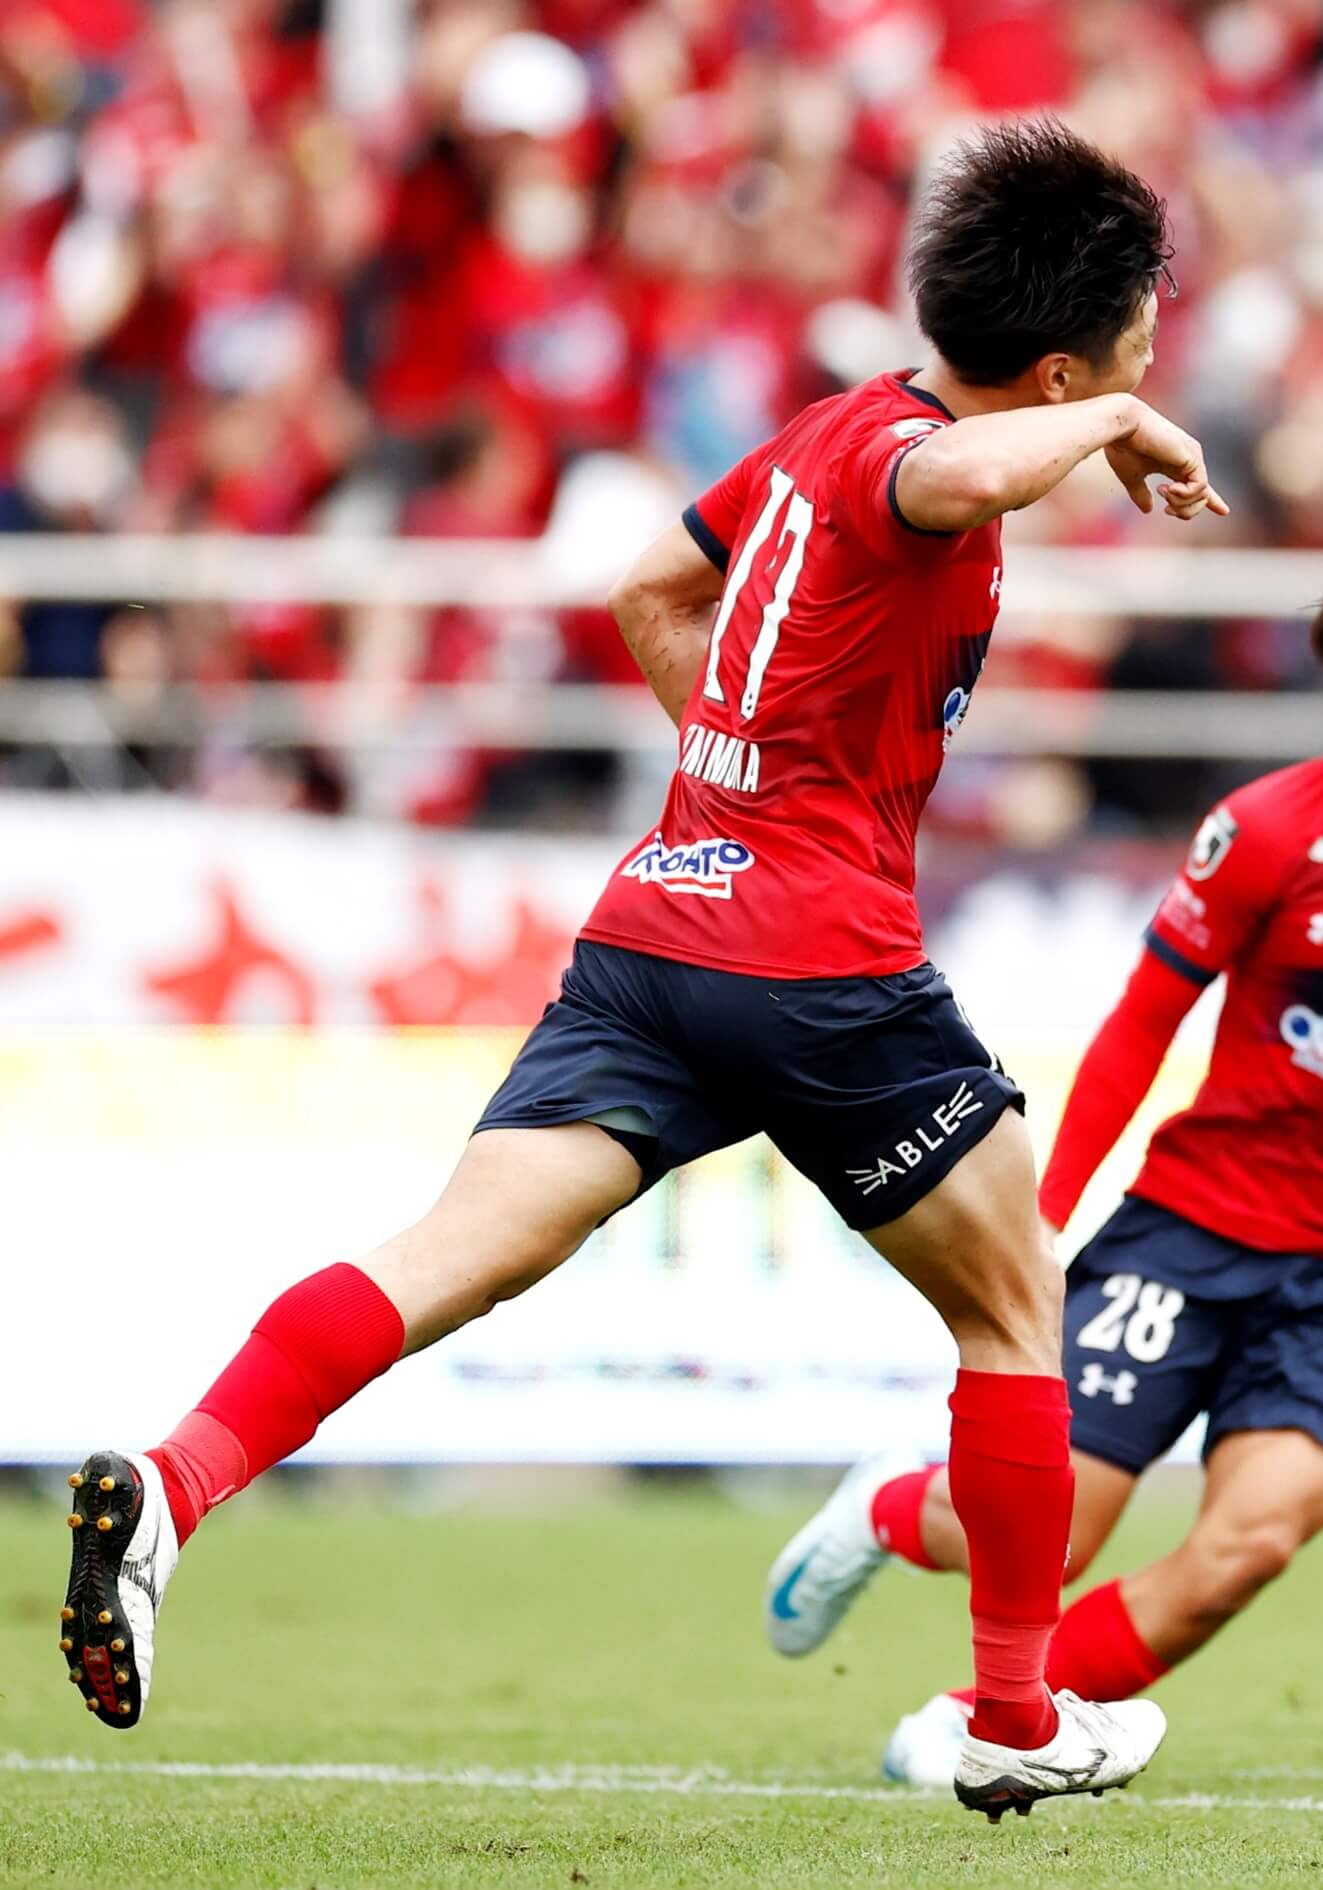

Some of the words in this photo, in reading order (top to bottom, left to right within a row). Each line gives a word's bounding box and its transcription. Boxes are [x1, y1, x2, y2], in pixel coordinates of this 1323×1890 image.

[702, 463, 814, 721] 17
[845, 1080, 984, 1196] ABLE
[1076, 1273, 1186, 1363] 28
